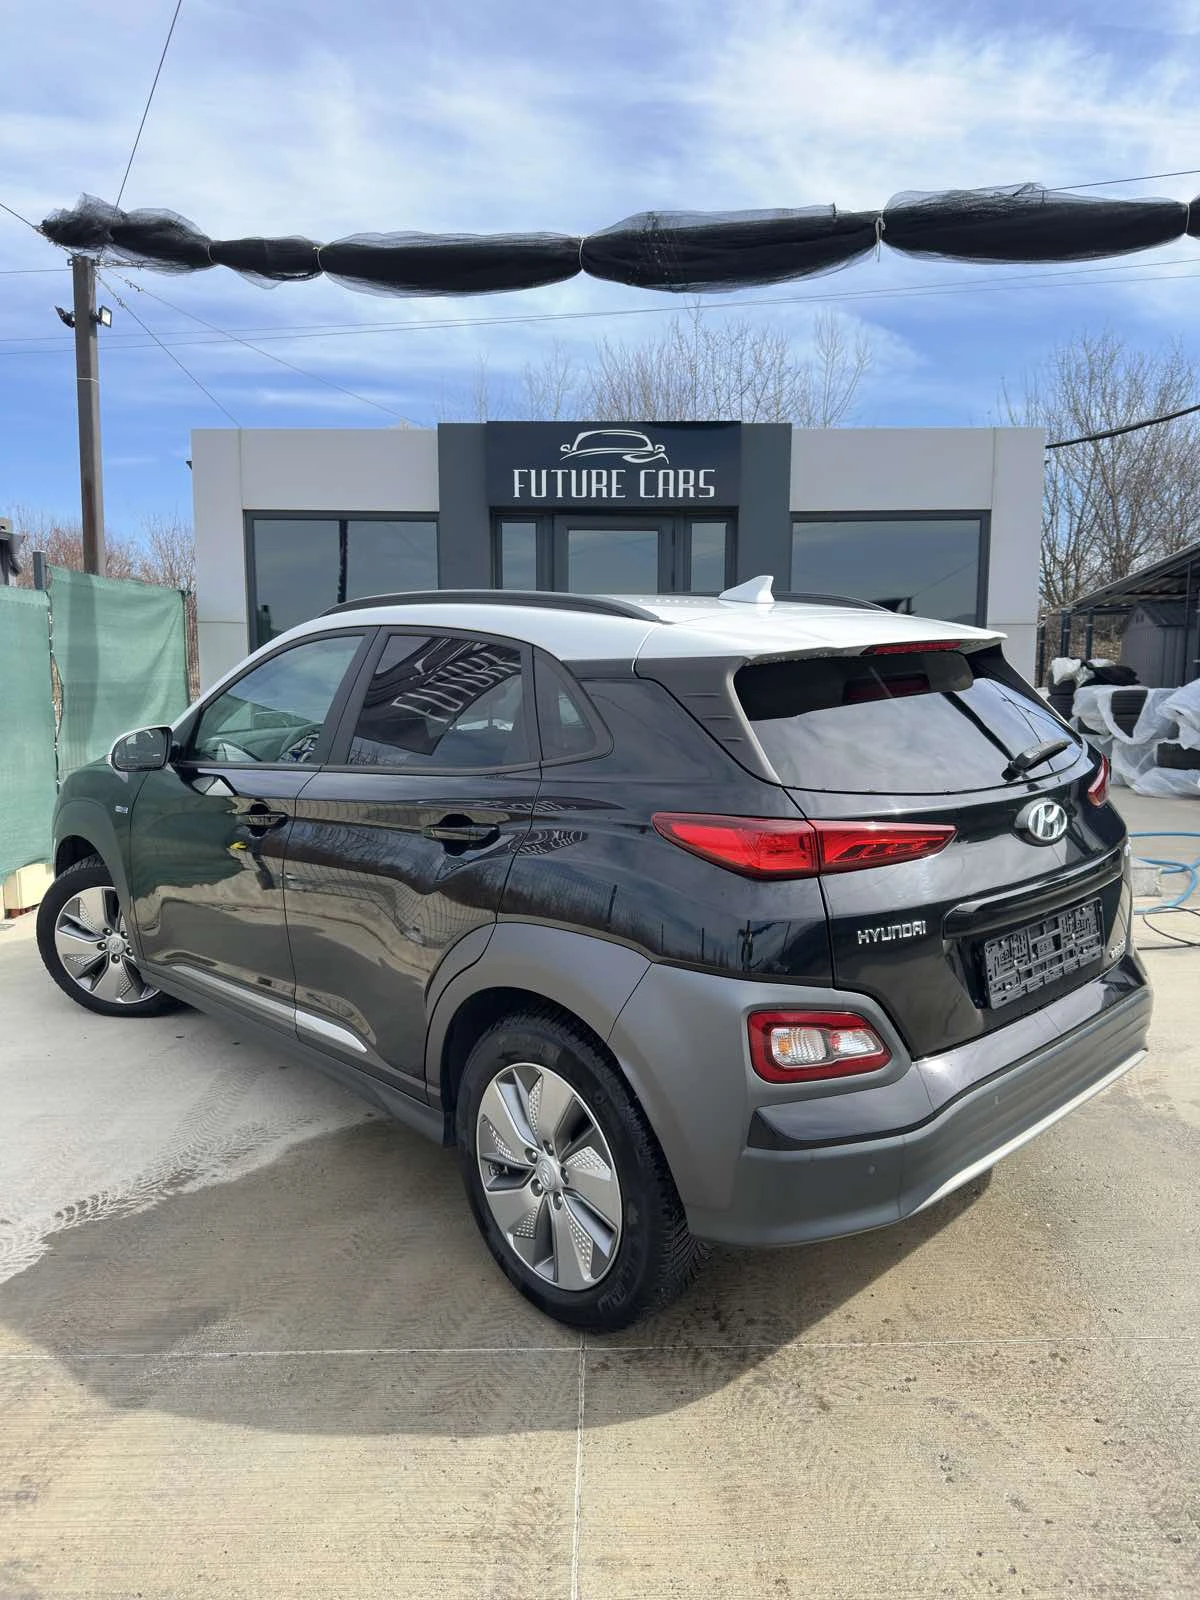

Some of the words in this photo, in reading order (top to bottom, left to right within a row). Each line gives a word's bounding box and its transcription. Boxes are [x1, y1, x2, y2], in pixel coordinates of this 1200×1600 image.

[512, 469, 627, 499] FUTURE
[639, 469, 716, 499] CARS
[857, 920, 927, 945] HYUNDAI
